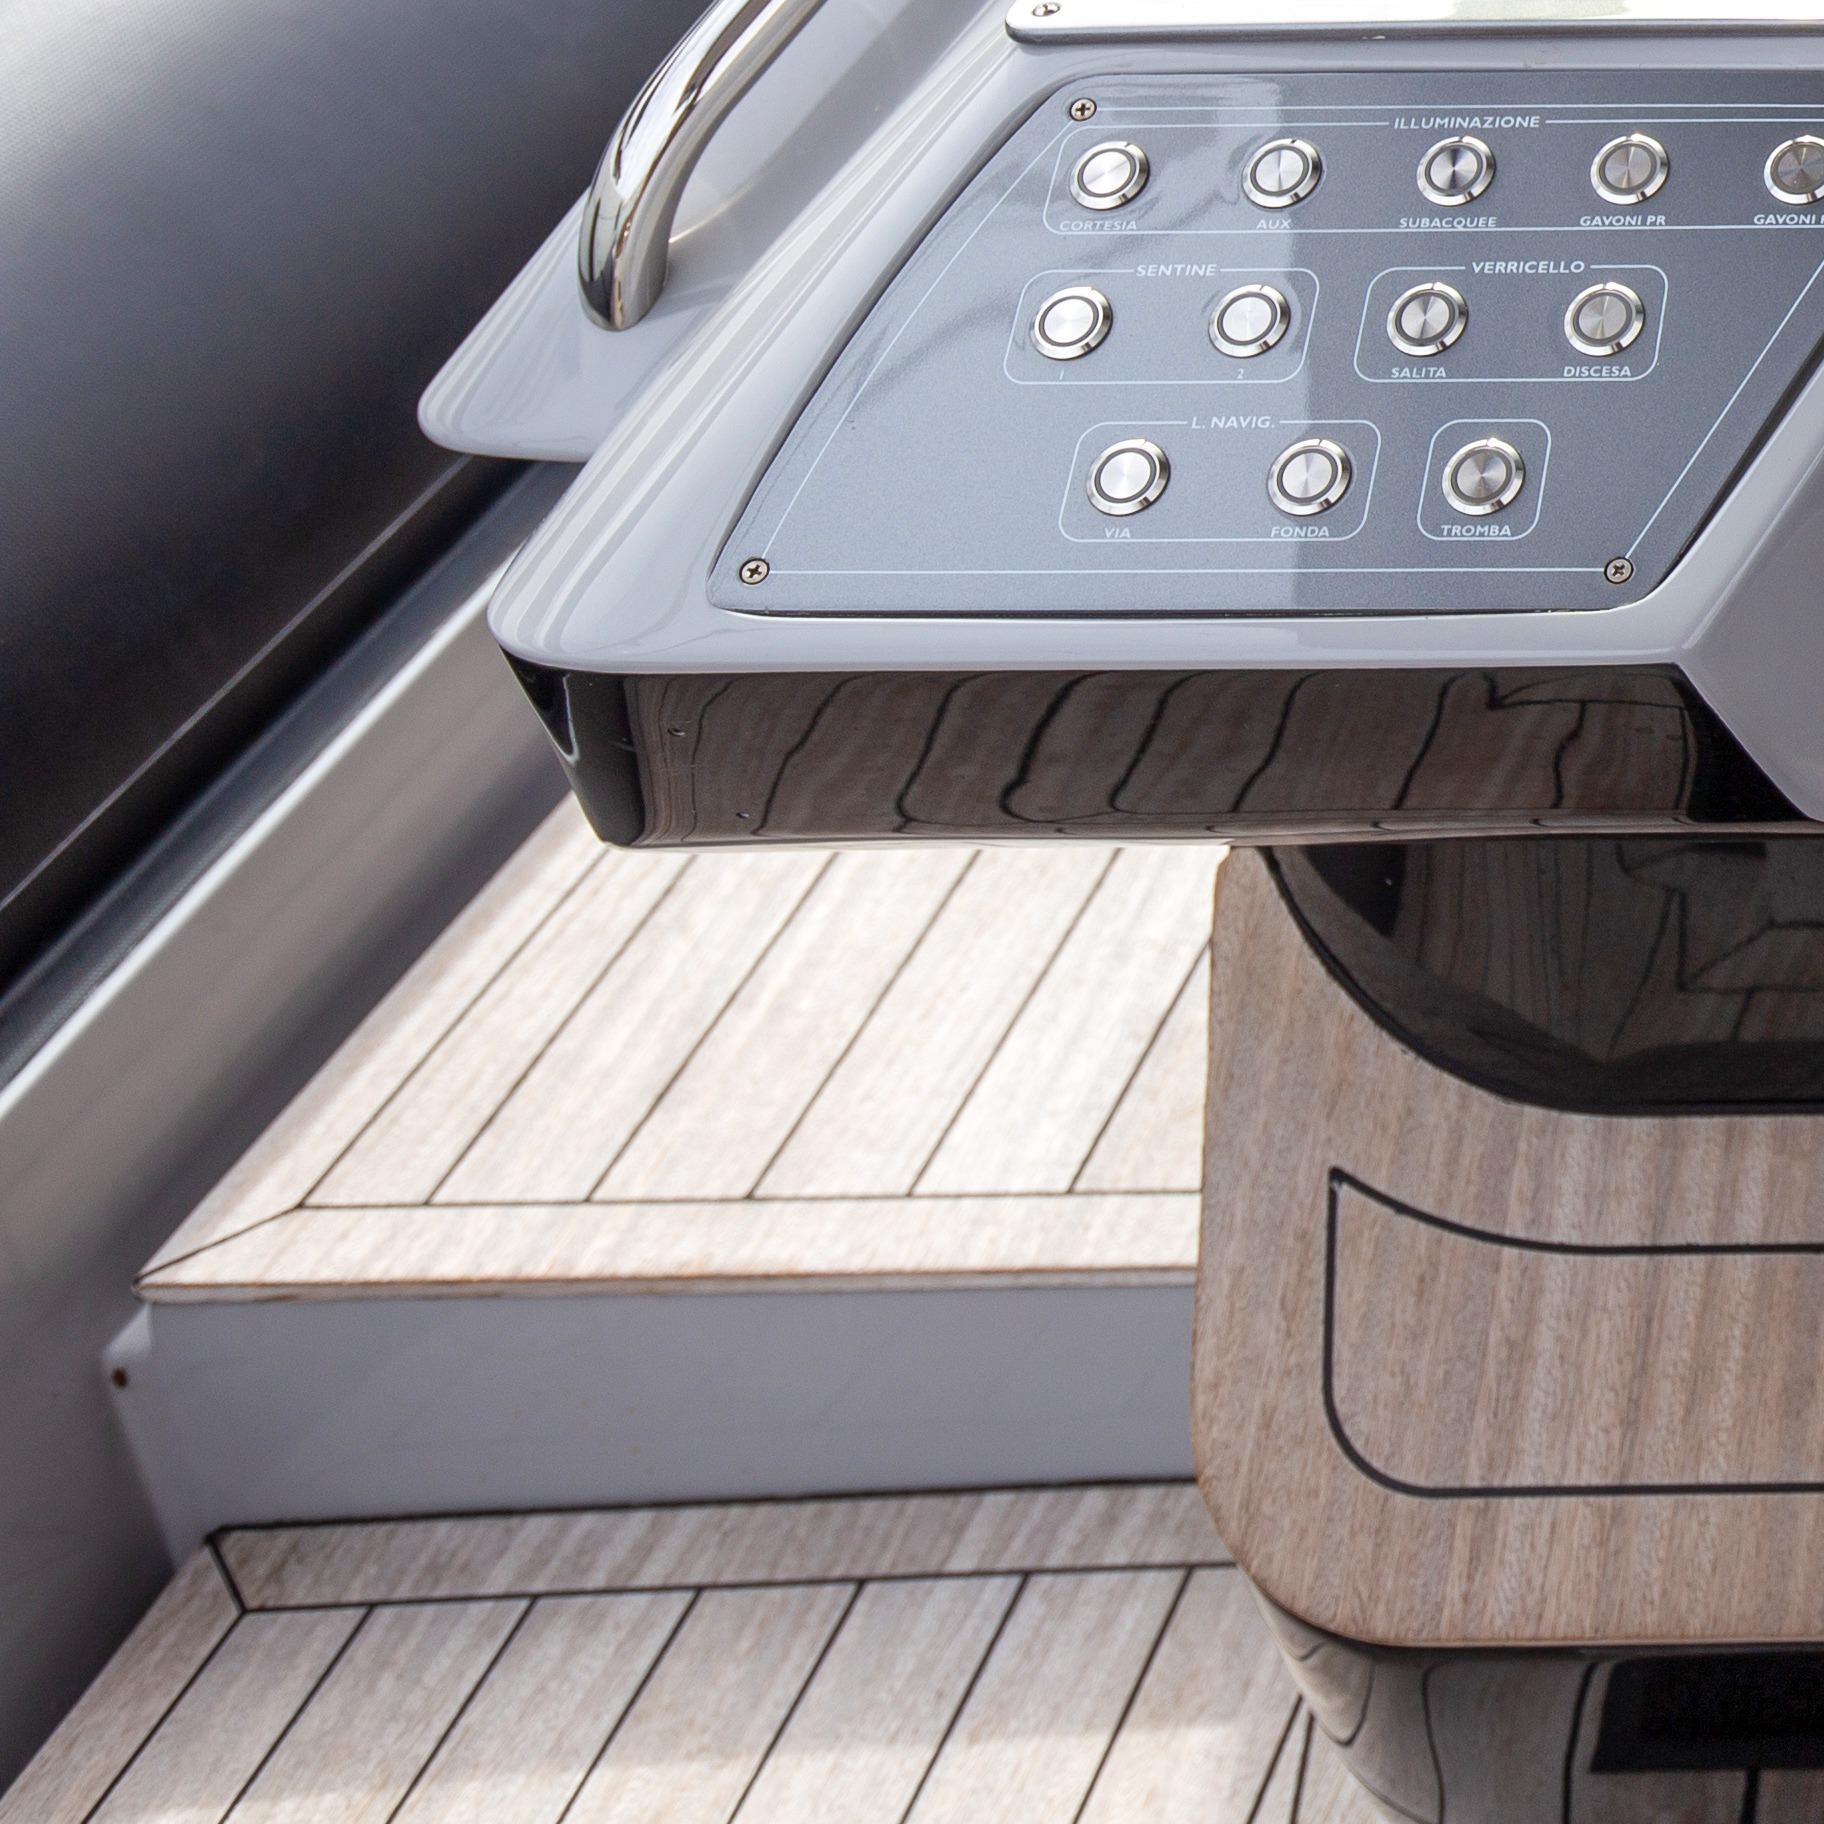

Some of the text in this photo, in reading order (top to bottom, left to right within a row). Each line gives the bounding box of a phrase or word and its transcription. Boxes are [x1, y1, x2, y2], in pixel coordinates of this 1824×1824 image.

[1394, 116, 1541, 129] ILLUMINAZIONE
[1058, 219, 1138, 232] CORTESIA
[1256, 218, 1293, 231] AUX
[1399, 216, 1498, 229] SUBACQUEE
[1579, 215, 1667, 227] GAVONI PR
[1753, 213, 1816, 225] GAVONI
[1136, 263, 1218, 277] SENTINE
[1471, 260, 1586, 274] VERRICELLO
[1236, 368, 1244, 380] 2
[1390, 366, 1447, 378] SALITA
[1563, 365, 1632, 378] DISCESA
[1191, 415, 1275, 429] L. NAVIG.
[1104, 527, 1132, 539] VIA
[1270, 526, 1331, 538] FONDA
[1440, 524, 1512, 537] TROMBA
